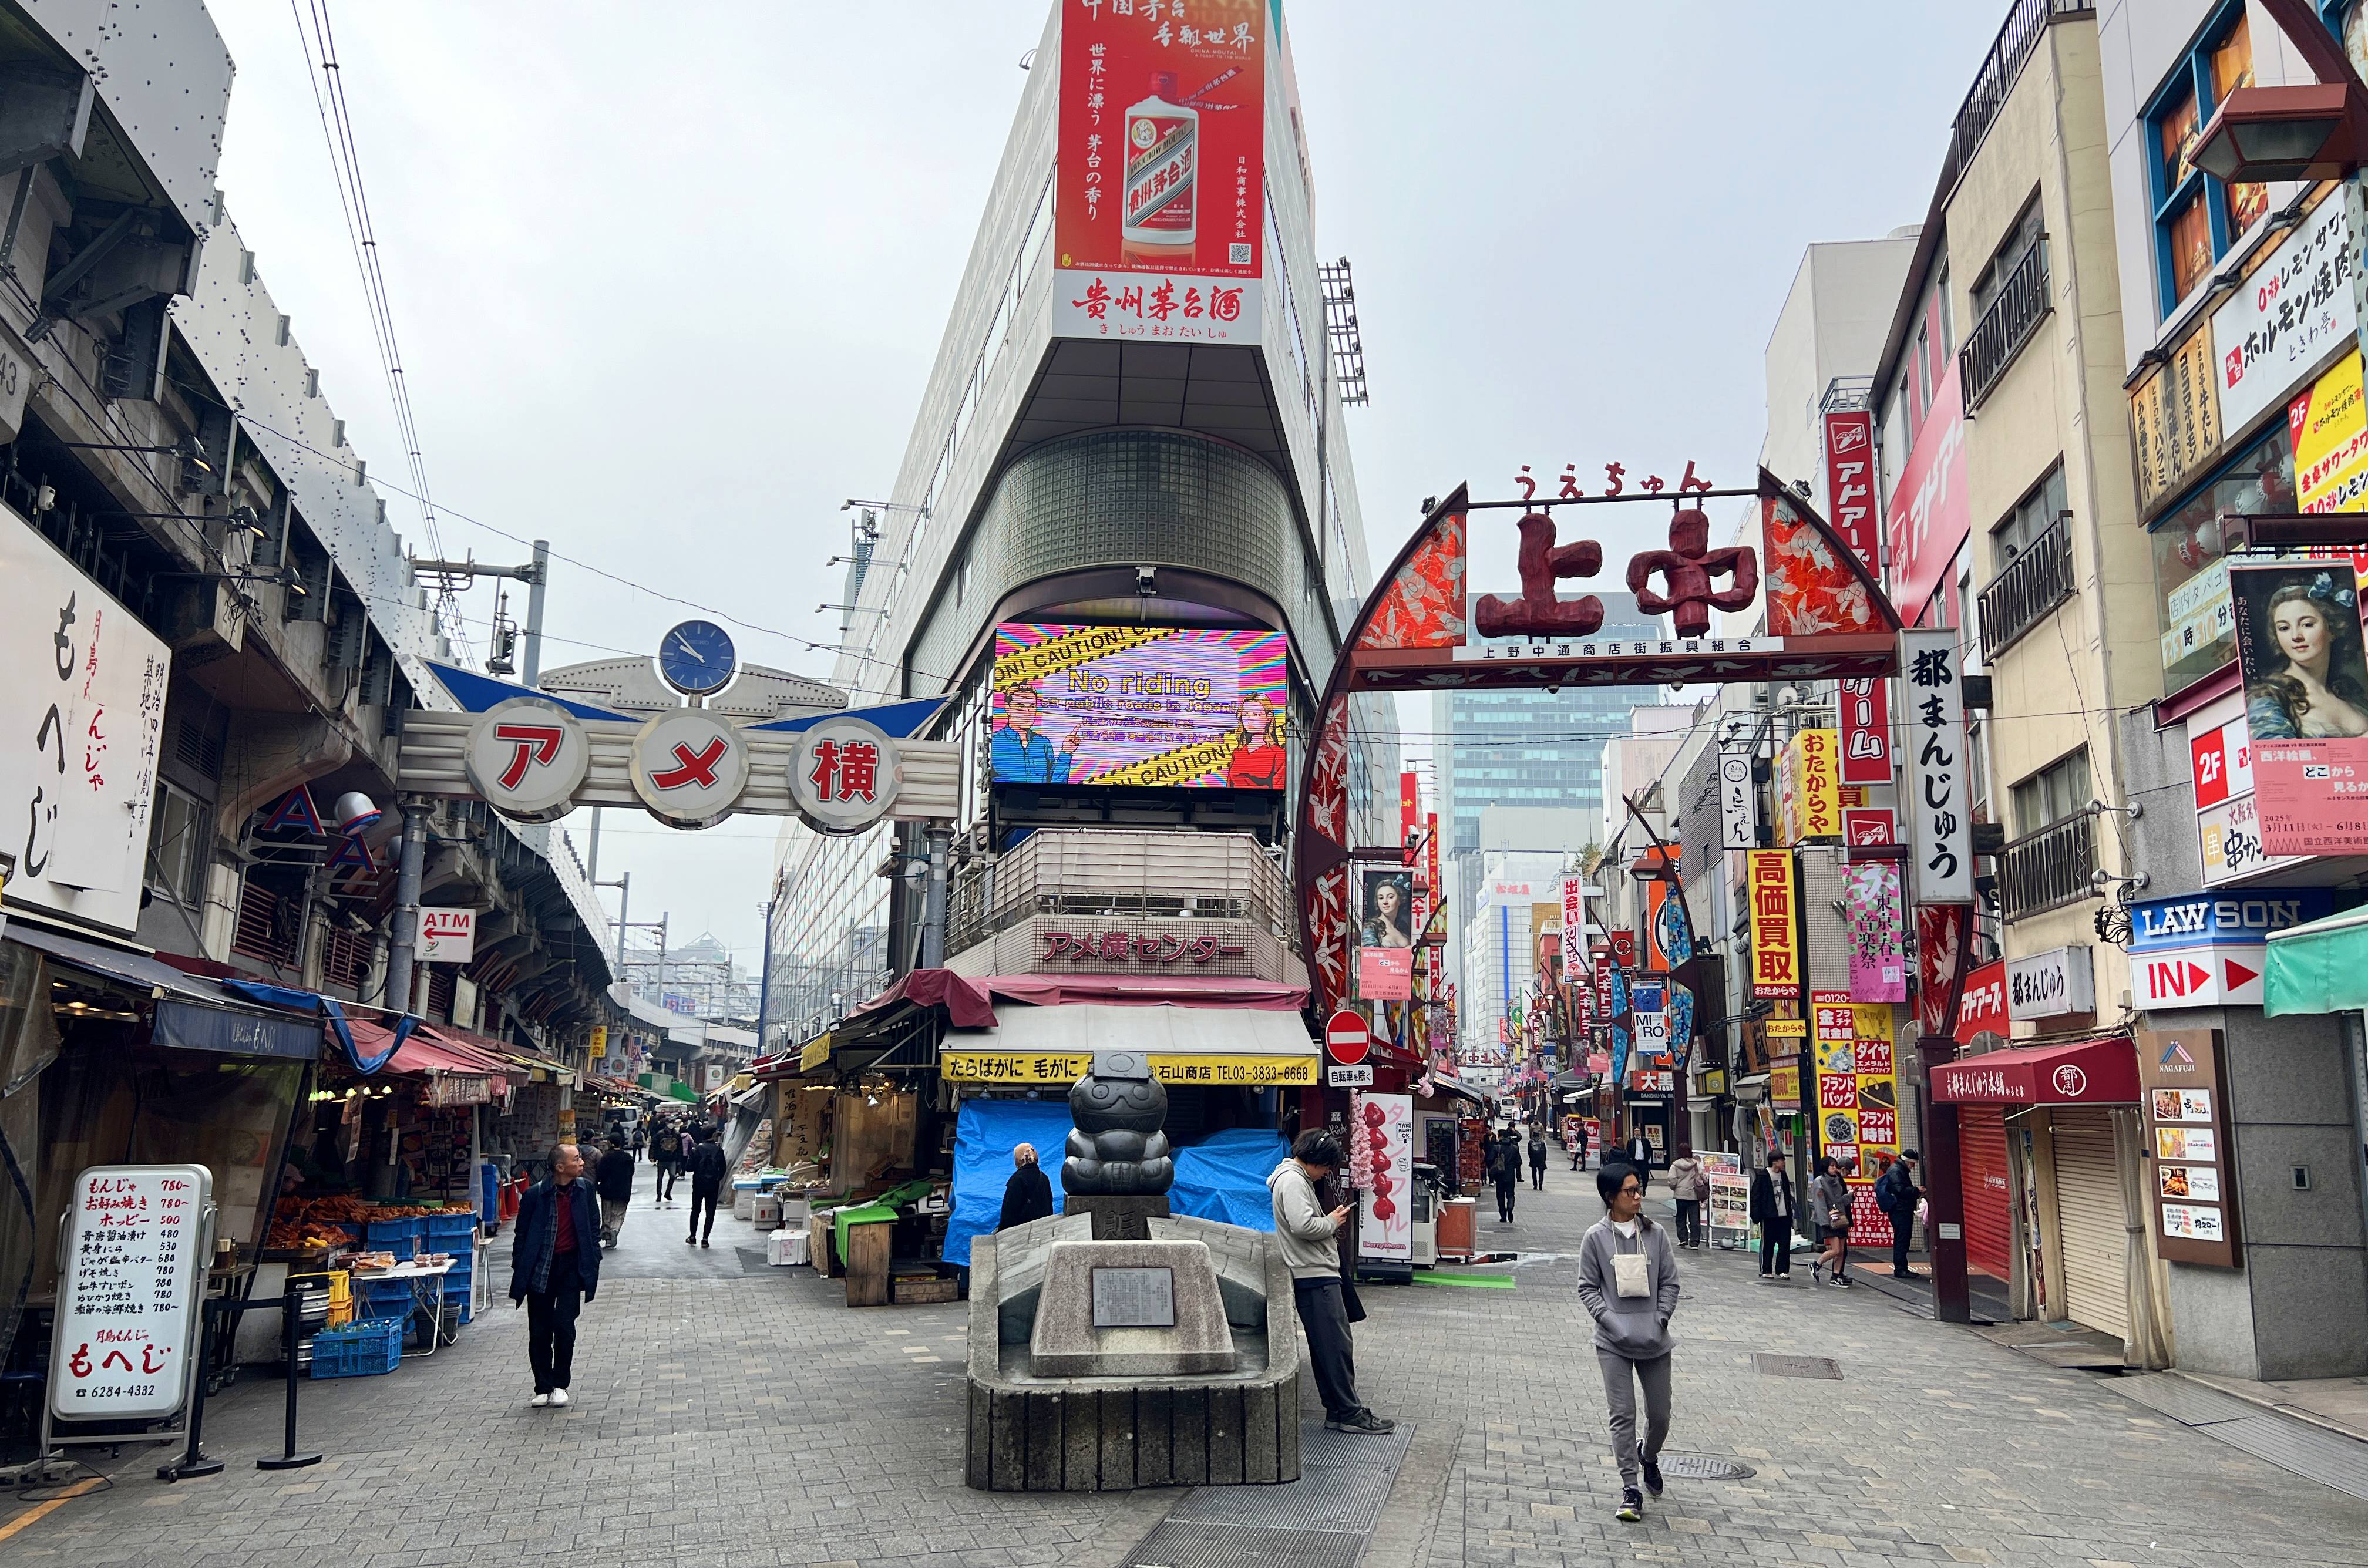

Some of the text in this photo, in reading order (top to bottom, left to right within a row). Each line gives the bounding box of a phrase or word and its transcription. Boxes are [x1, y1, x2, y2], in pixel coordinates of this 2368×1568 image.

[1087, 43, 1107, 126] 世界に漂う
[1084, 134, 1104, 221] 茅台の香り
[1235, 156, 1247, 238] 日和商事株式会社
[2291, 401, 2308, 428] 2F
[1513, 460, 1712, 500] うえちゅん
[1034, 627, 1124, 668] CAUTION!
[1482, 639, 1752, 659] 上野中通商店街振興組合
[1067, 670, 1212, 699] No riding
[26, 590, 75, 878] もへじ
[493, 724, 879, 806] アメ横
[1909, 648, 1959, 879] 都まんじゅう
[2199, 749, 2221, 785] 2F
[2305, 766, 2355, 778] どこから
[1804, 733, 1829, 833] おたからや
[423, 913, 470, 928] ATM
[1753, 851, 1793, 982] 高価買取
[2141, 900, 2303, 936] LAWSON
[1042, 930, 1245, 963] アメ横センター
[2012, 965, 2064, 1007] 都まんじゅう
[2148, 960, 2185, 998] IN
[1754, 985, 1798, 997] おたからや
[1961, 981, 2002, 1023] アドアーズ
[1818, 1008, 1835, 1026] 金
[1765, 1023, 1806, 1033] おたからや
[1819, 1027, 1853, 1040] 貴金属
[1856, 1042, 1891, 1060] ダイヤ
[949, 1057, 1024, 1078] たらばがに
[1033, 1059, 1078, 1079] 毛がに
[1331, 1069, 1371, 1083] 自転車を除く
[2159, 1064, 2195, 1072] NAGAFUJI
[1821, 1075, 1855, 1091] ブランド
[1822, 1091, 1856, 1108] バッグ
[1859, 1111, 1894, 1126] ブランド
[1861, 1126, 1893, 1144] 時計
[89, 1178, 137, 1194] もんじゃ
[85, 1194, 147, 1210] お好み焼き
[99, 1213, 180, 1227] ホッピー 500
[160, 1230, 179, 1239] 480
[159, 1241, 177, 1251] 530
[157, 1253, 176, 1263] 680
[156, 1266, 175, 1275] 780
[155, 1278, 172, 1288] 780
[154, 1290, 173, 1299] 780
[69, 1343, 172, 1378] もへじ
[91, 1385, 155, 1398] 6284-4332
